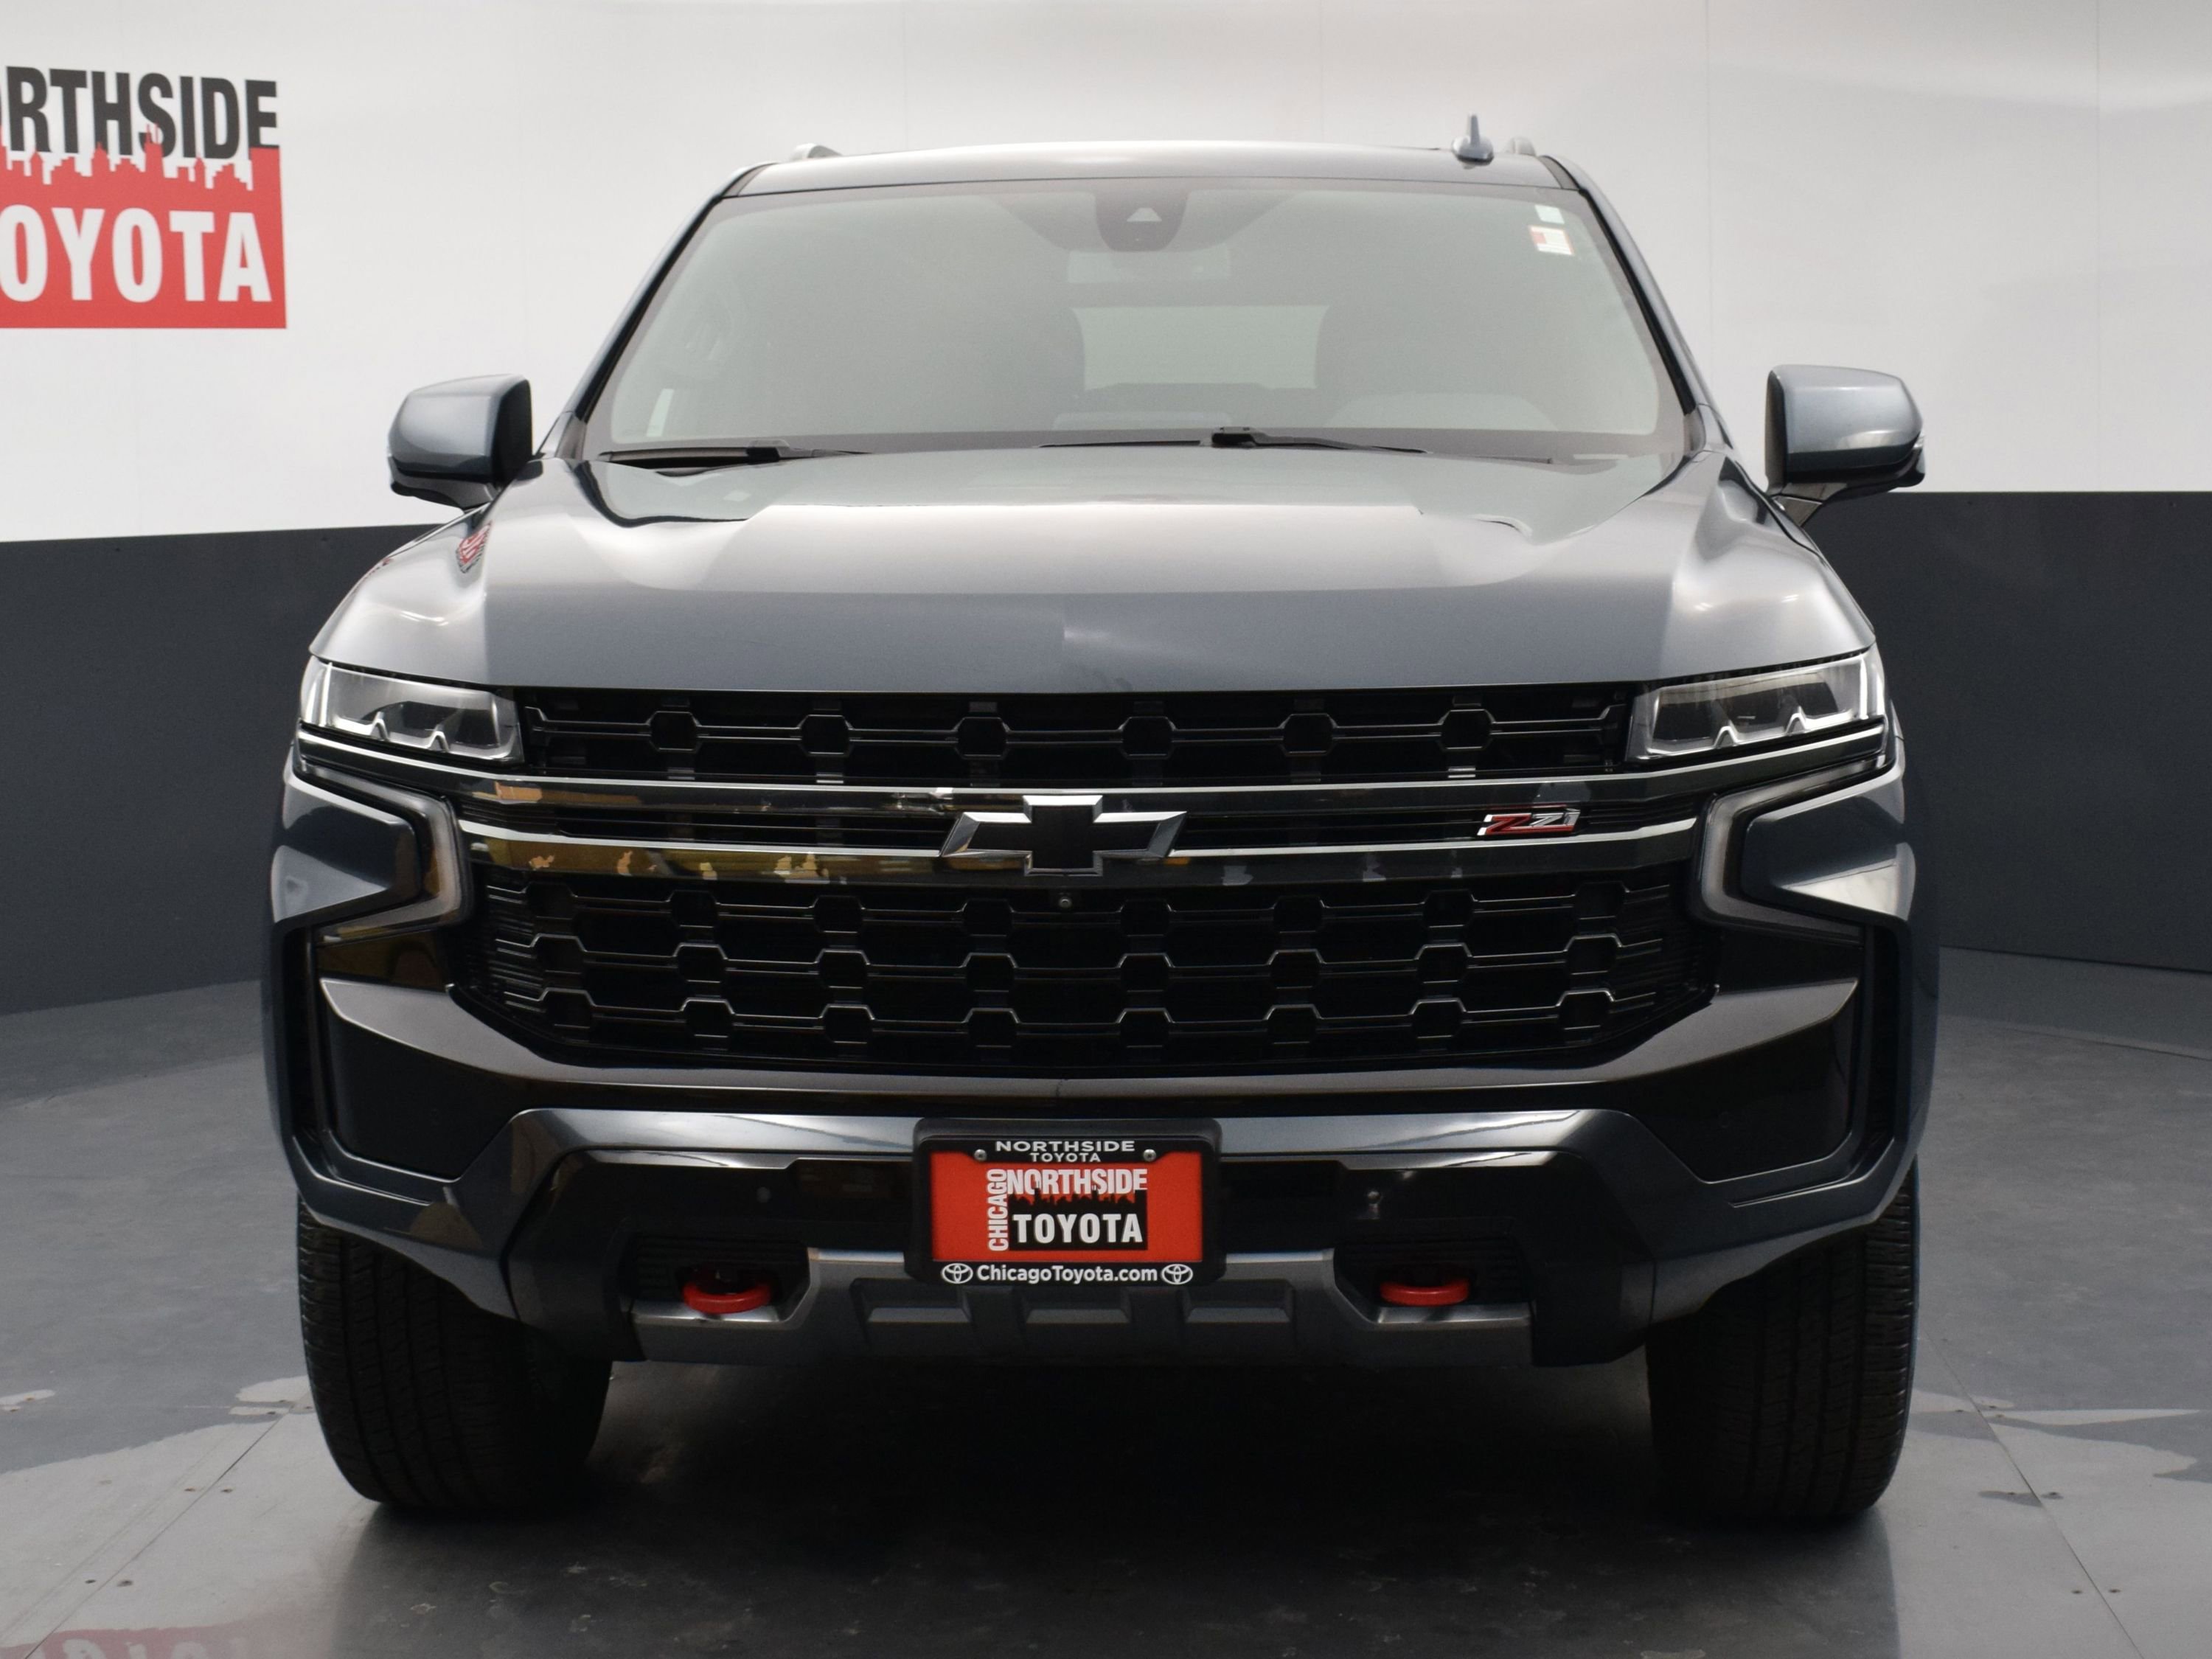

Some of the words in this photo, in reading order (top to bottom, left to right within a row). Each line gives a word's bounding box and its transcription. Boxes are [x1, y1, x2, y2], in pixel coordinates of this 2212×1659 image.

[0, 66, 279, 159] RTHSIDE
[0, 204, 273, 302] OYOTA
[1477, 812, 1581, 836] Z71
[995, 1141, 1135, 1152] NORTHSIDE
[1030, 1152, 1101, 1163] TOYOTA
[1006, 1169, 1148, 1194] NORTHSIDE
[987, 1169, 1009, 1251] CHICAGO
[1012, 1213, 1143, 1243] TOYOTA
[977, 1265, 1158, 1284] ChicagoToyota.com
